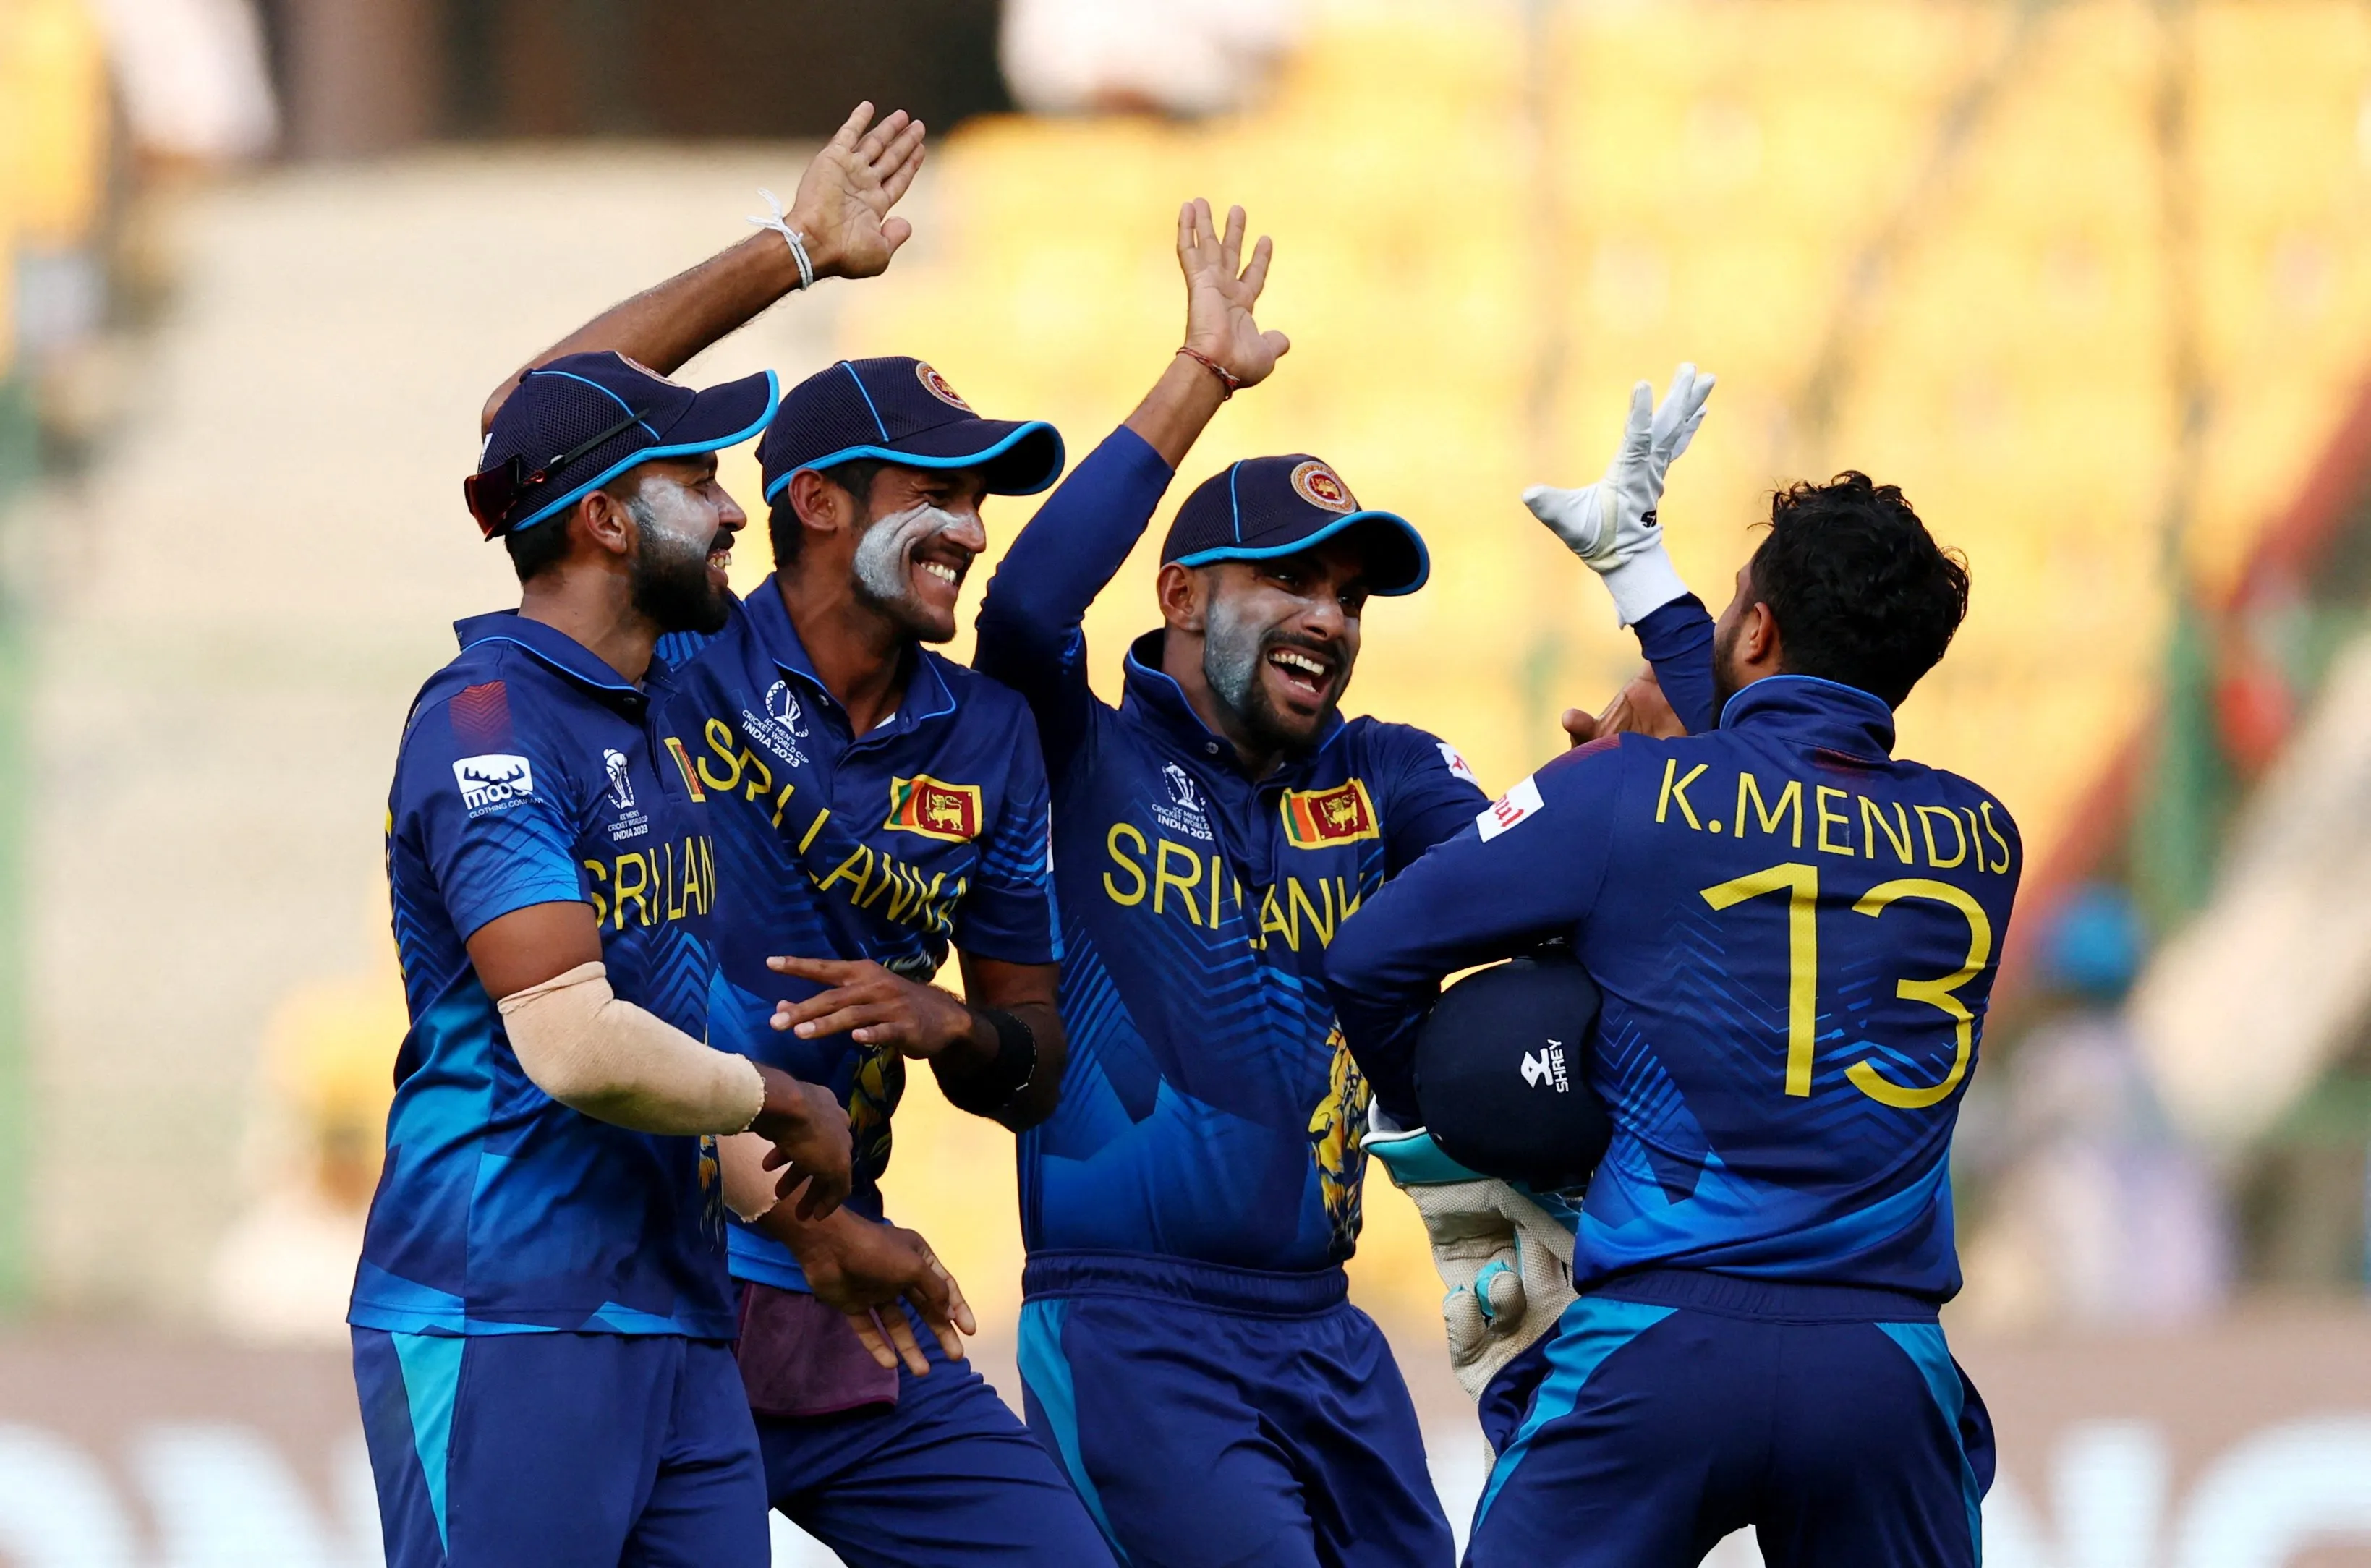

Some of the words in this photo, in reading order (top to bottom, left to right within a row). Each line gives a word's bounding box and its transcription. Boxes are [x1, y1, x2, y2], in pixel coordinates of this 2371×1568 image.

[742, 710, 771, 733] CRICKET
[771, 731, 796, 753] WORLD
[795, 751, 809, 764] CUP
[742, 720, 771, 749] INDIA
[771, 743, 800, 767] 2023
[764, 718, 776, 729] ICC
[698, 717, 795, 830] SRI
[469, 803, 507, 819] CLOTHING
[613, 828, 634, 841] INDIA
[633, 823, 649, 836] 2023
[1152, 804, 1181, 821] CRICKET
[1183, 817, 1210, 830] WORLD
[1157, 814, 1189, 834] INDIA
[1190, 827, 1214, 841] 202
[1655, 758, 2010, 876] K.MENDIS
[584, 848, 660, 930] SRI
[665, 835, 715, 921] LAN
[1103, 822, 1220, 930] SRI
[1700, 862, 1993, 1110] 13
[1547, 1039, 1569, 1093] SHREY
